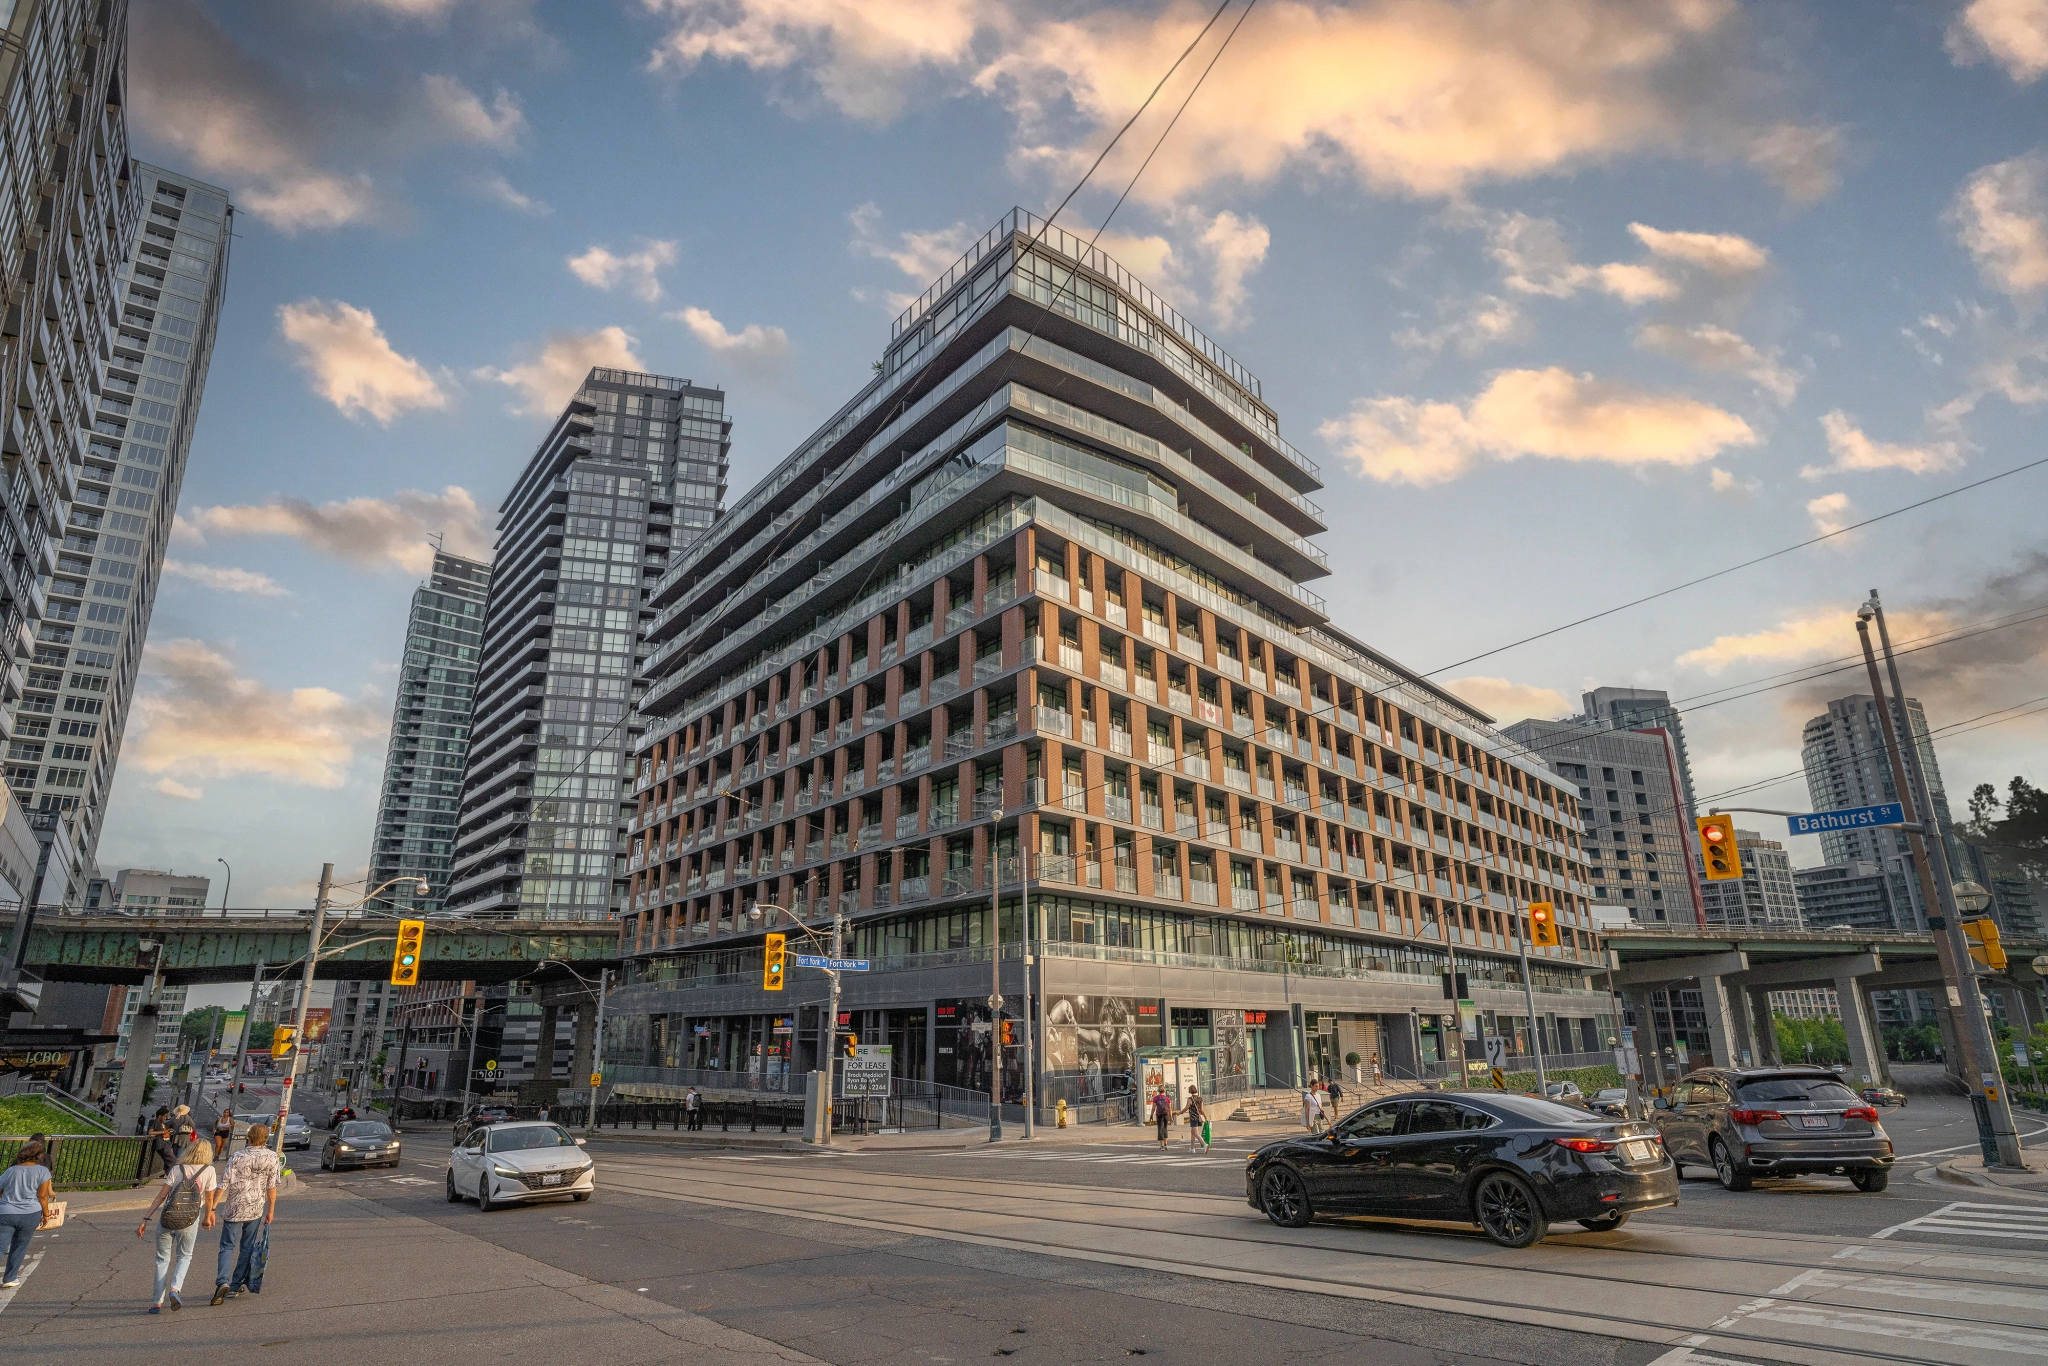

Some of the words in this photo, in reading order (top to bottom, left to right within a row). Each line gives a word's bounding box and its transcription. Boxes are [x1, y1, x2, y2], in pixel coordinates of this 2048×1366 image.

[1797, 809, 1876, 831] Bathurst
[1880, 807, 1891, 815] St
[798, 956, 809, 965] Fort
[810, 957, 820, 966] York
[829, 960, 842, 968] Fort
[843, 960, 856, 968] York
[1245, 1012, 1254, 1023] BIG
[1255, 1012, 1266, 1023] HIT
[25, 1051, 62, 1064] LCBO
[847, 1061, 863, 1069] FOR
[865, 1061, 886, 1069] LEASE
